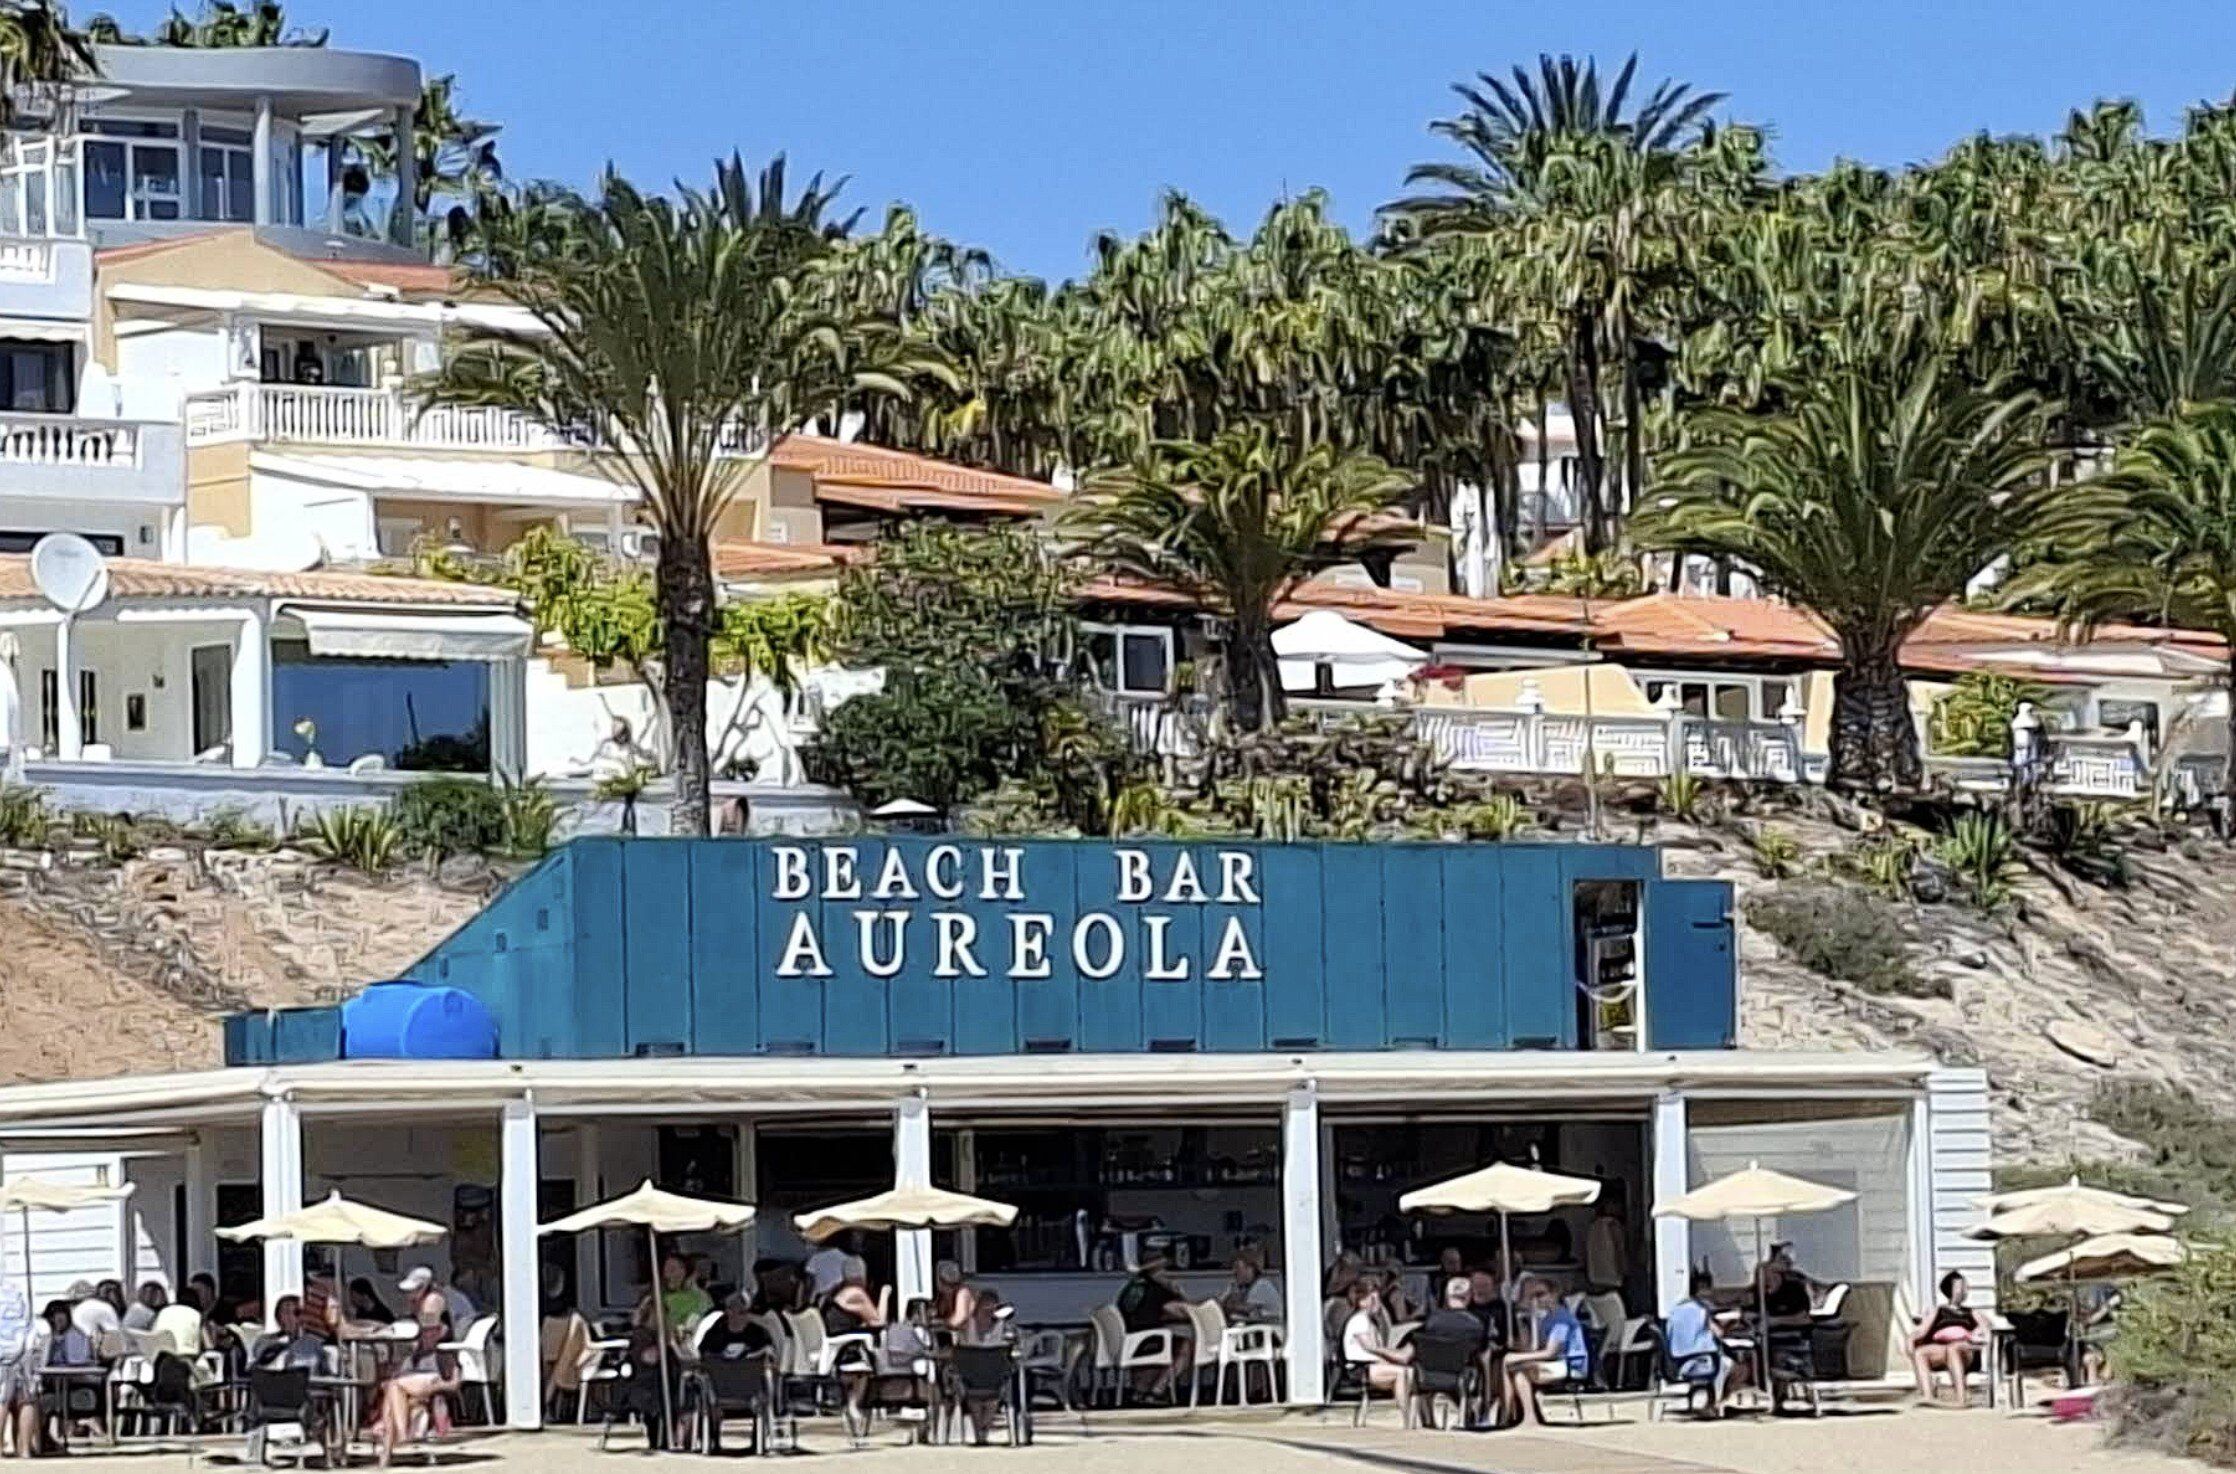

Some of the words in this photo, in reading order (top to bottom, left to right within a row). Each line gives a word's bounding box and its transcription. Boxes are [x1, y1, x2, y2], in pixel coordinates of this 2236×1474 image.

[771, 845, 1025, 900] BEACH
[1114, 849, 1261, 903] BAR
[776, 910, 1263, 978] AUREOLA
